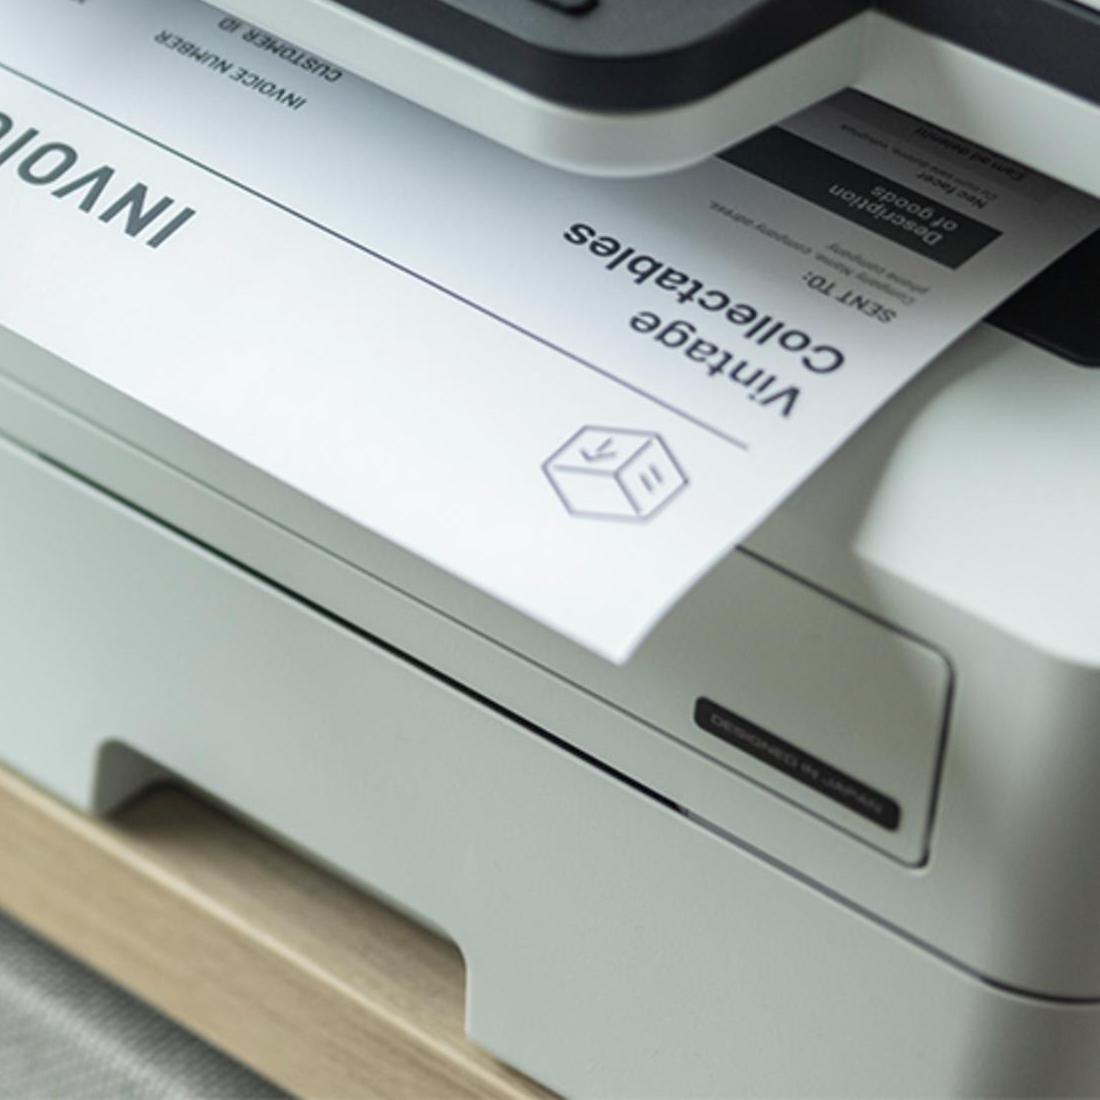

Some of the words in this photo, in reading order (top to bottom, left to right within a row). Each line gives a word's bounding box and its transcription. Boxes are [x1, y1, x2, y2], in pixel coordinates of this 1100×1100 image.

[218, 16, 242, 33] ID
[154, 30, 234, 75] NUMBER
[241, 28, 343, 83] CUSTOMER
[228, 65, 307, 110] INVOICE
[915, 171, 956, 195] facer
[955, 190, 988, 210] Nec
[828, 184, 943, 246] Description
[870, 186, 934, 220] goods
[754, 222, 812, 255] company
[929, 215, 958, 232] of
[826, 242, 886, 274] company
[563, 221, 845, 375] Collectables
[801, 271, 837, 297] TO:
[855, 272, 916, 306] Company
[834, 289, 898, 325] SENT
[629, 311, 801, 418] Vintage
